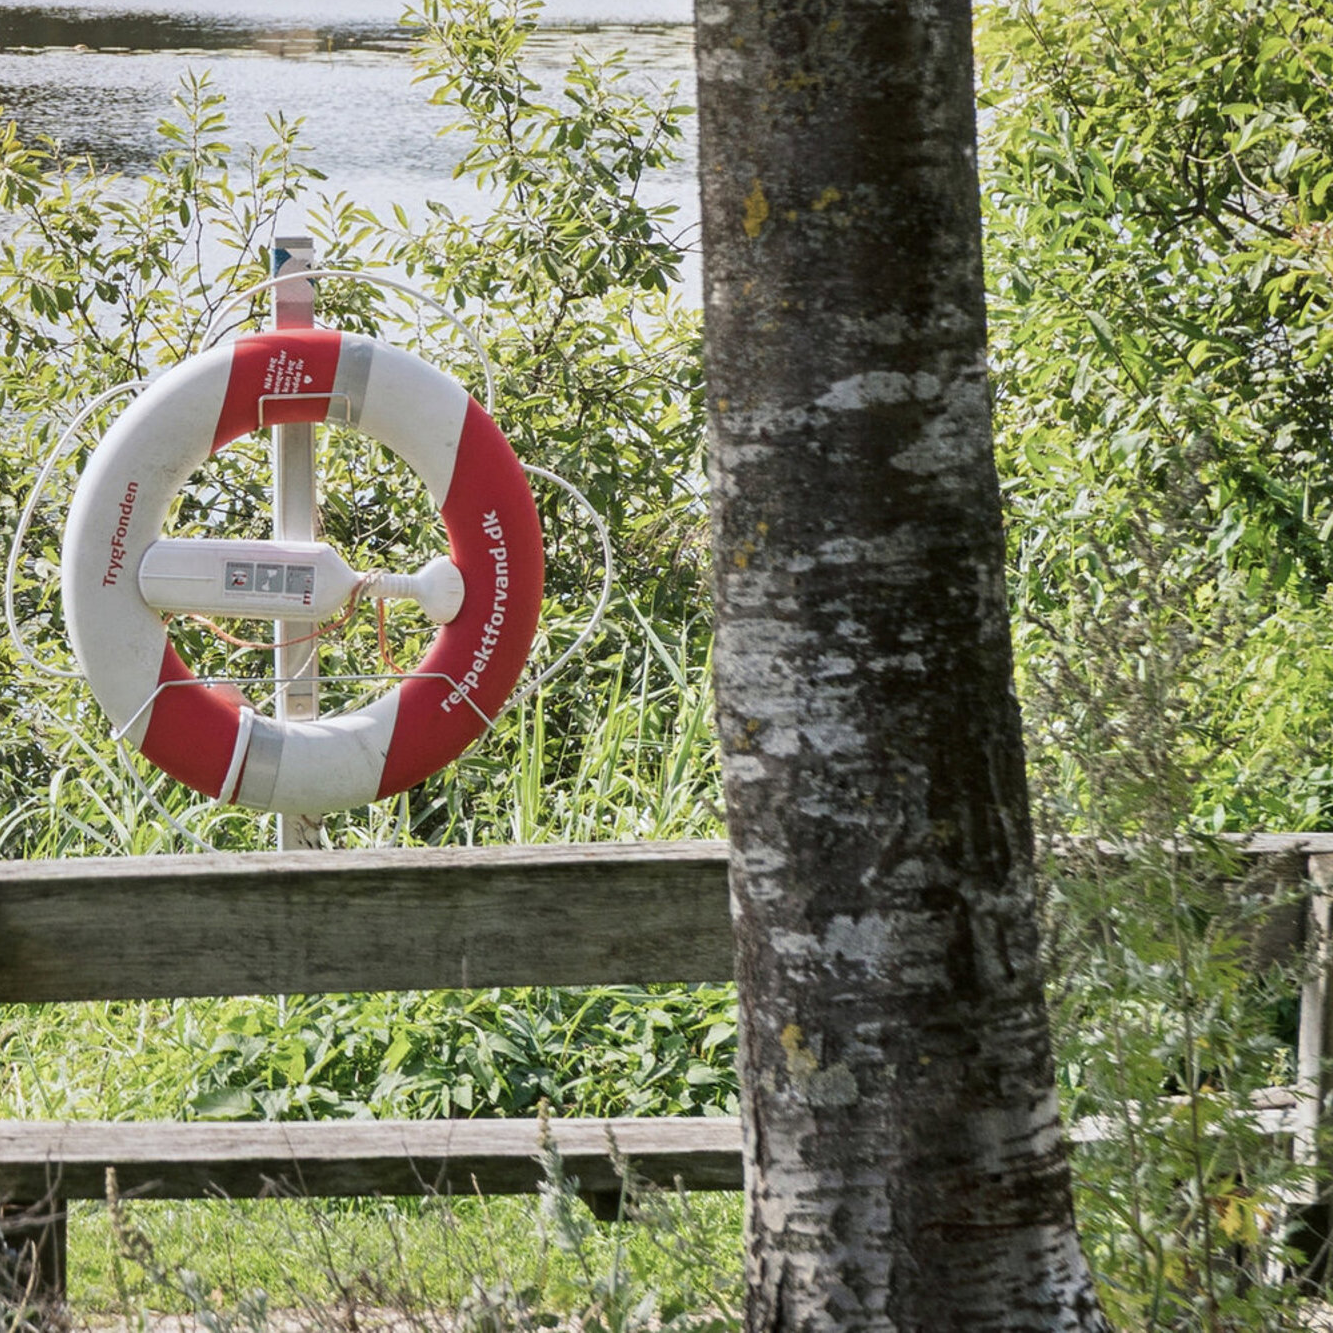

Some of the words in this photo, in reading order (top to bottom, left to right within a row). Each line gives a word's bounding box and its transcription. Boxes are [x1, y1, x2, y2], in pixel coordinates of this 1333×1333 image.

[266, 357, 278, 373] jeg
[284, 359, 296, 375] jeg
[273, 366, 284, 394] ænger
[281, 376, 292, 393] kan
[292, 371, 302, 394] edde
[102, 481, 139, 587] TrygFonden
[440, 509, 510, 714] respektforvand.dk
